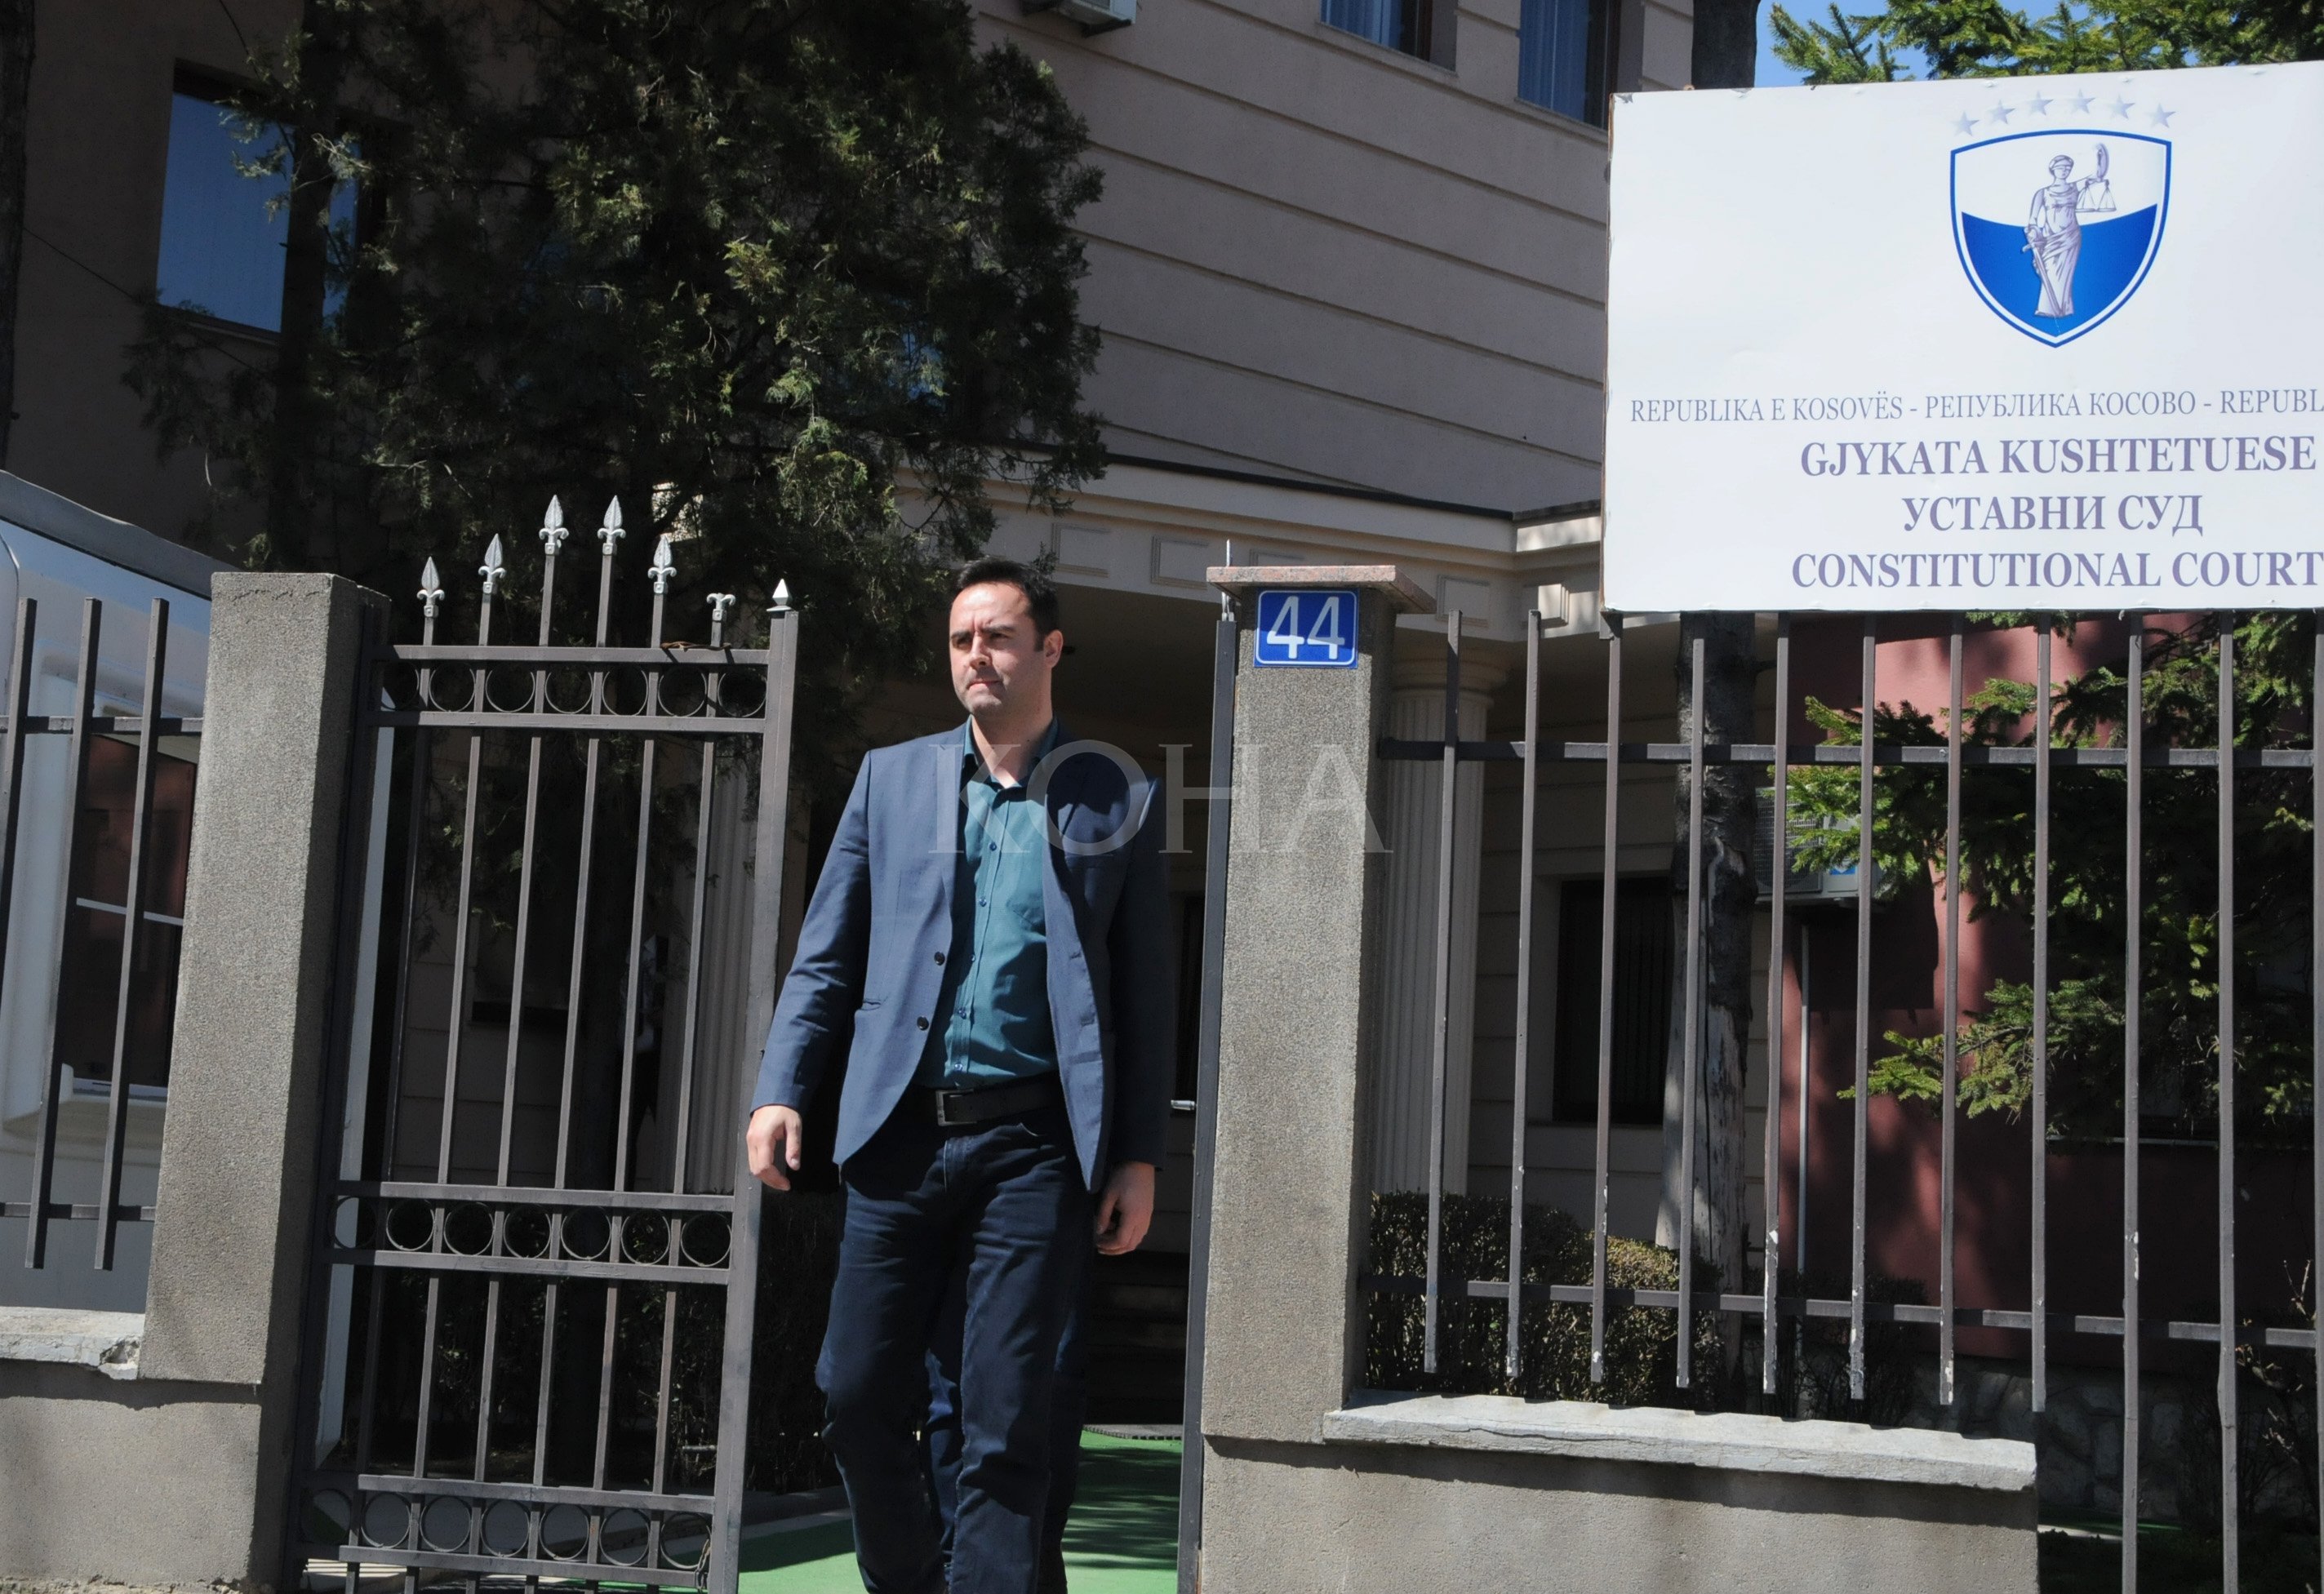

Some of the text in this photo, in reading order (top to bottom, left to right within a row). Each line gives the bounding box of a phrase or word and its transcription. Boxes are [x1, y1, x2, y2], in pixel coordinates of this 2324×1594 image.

[1630, 397, 1765, 422] REPUBLIKA
[1771, 398, 1786, 421] E
[1793, 389, 1904, 421] KOSOVËS
[1925, 393, 2082, 420] РЕПУБЛИКА
[2089, 390, 2196, 417] КОСОВО
[2220, 389, 2324, 414] REPUBL
[1800, 435, 2317, 477] GJYKATA KUSHTETUESE
[1901, 494, 2203, 538] УСТАВНИ СУД
[1792, 550, 2324, 589] CONSTITUTIONAL COURT
[1265, 595, 1346, 660] 44
